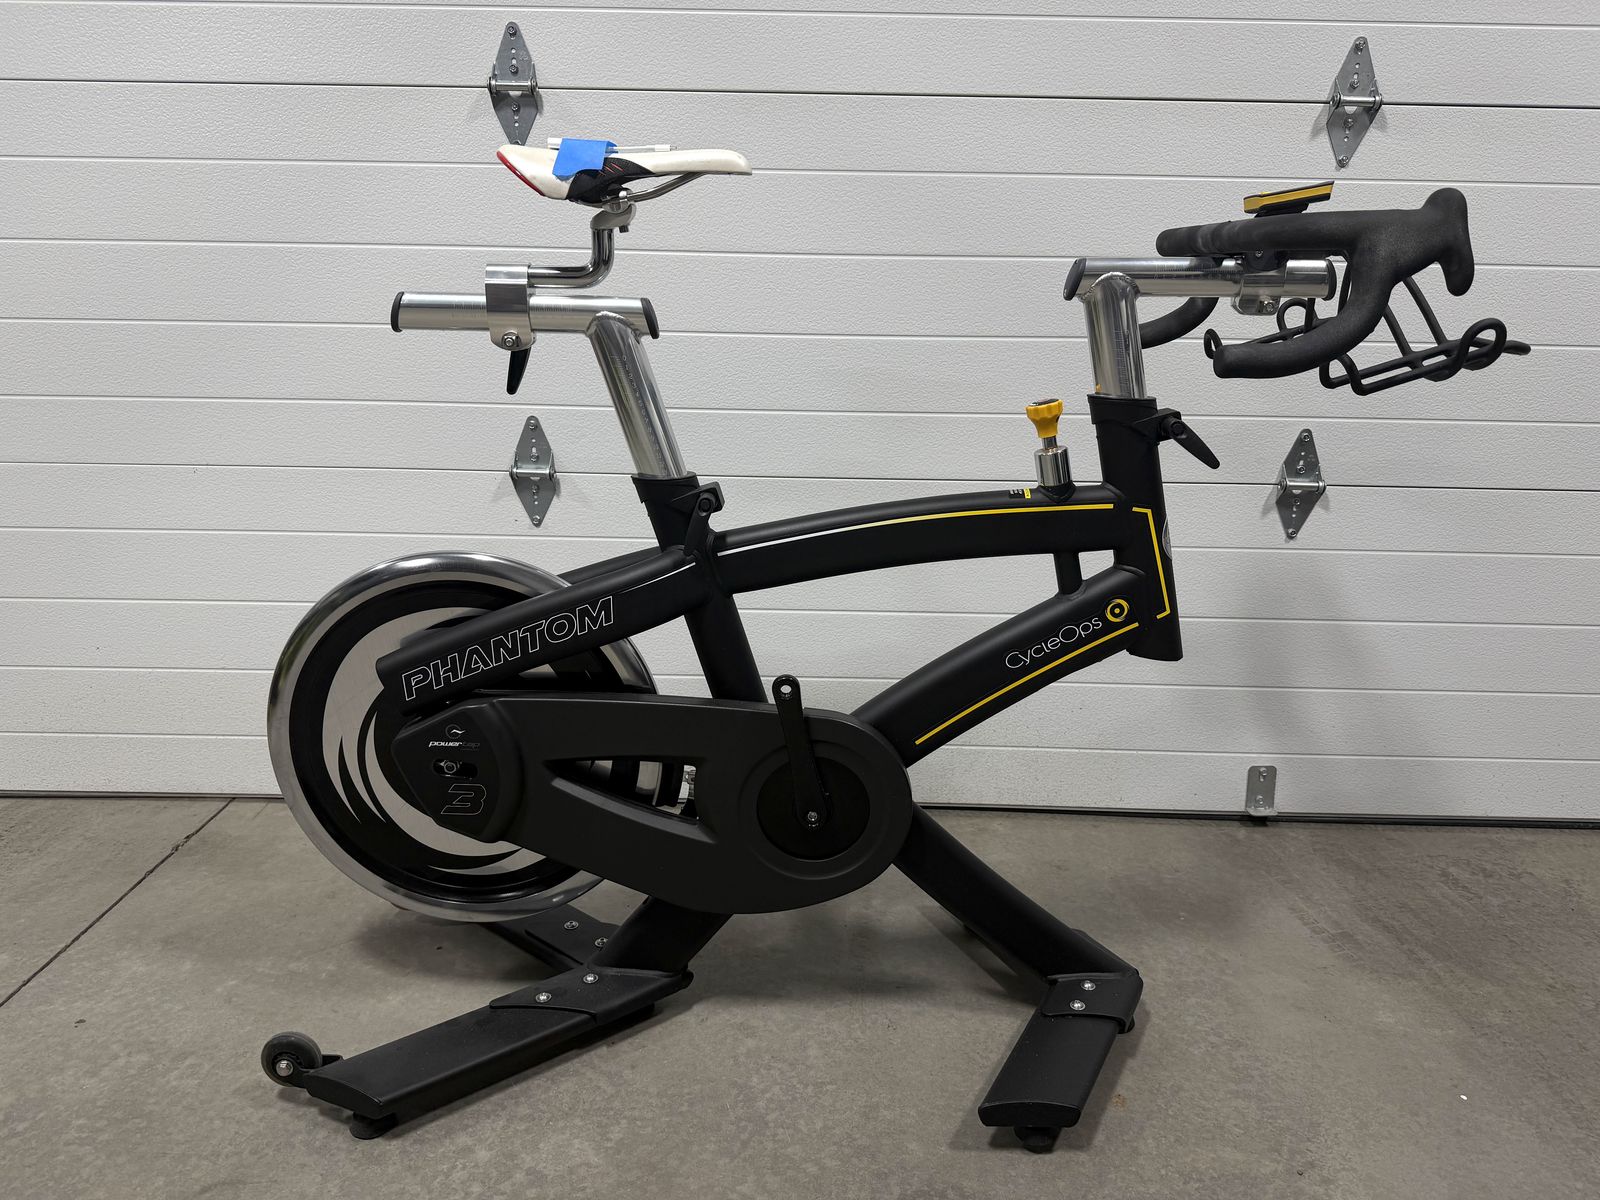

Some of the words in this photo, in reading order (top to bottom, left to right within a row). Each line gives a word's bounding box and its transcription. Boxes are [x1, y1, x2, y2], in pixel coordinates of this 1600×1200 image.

[401, 596, 614, 701] PHANTOM
[1005, 617, 1103, 669] CycleOps
[440, 783, 487, 816] 3
